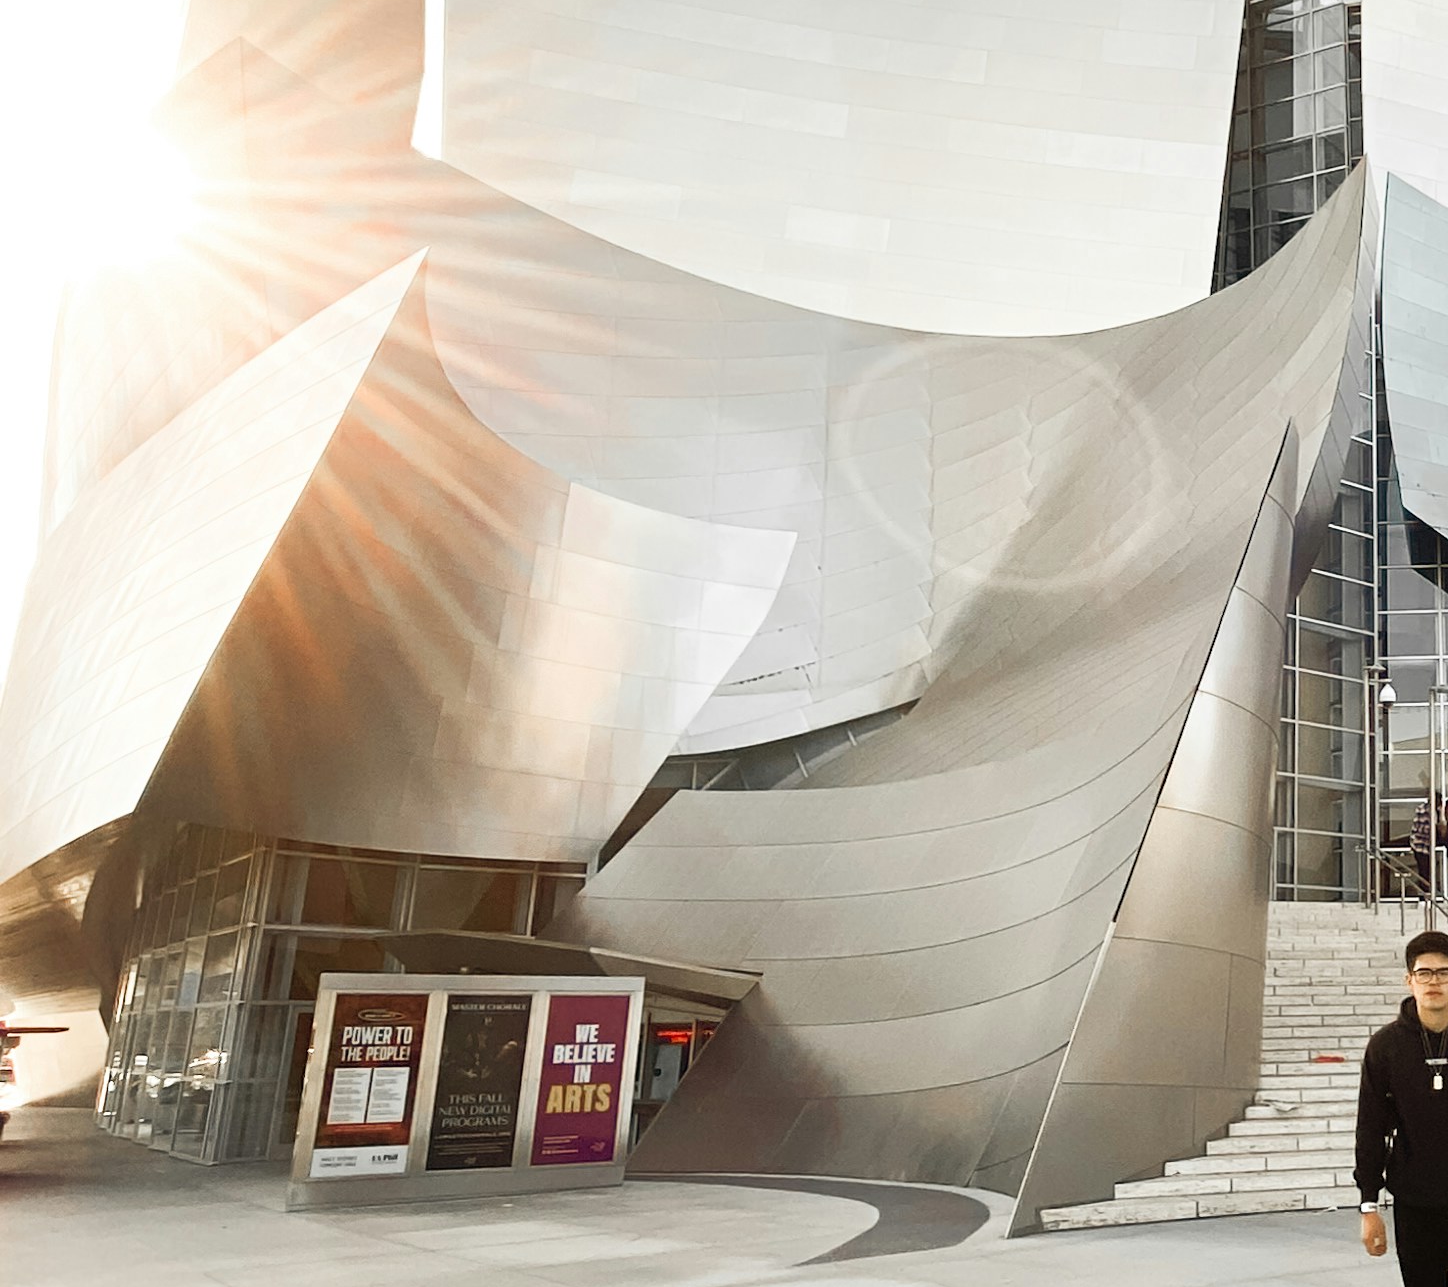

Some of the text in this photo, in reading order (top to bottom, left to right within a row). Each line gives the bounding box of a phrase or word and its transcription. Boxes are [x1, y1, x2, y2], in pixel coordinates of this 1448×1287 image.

[342, 1026, 413, 1045] POWER TO
[575, 1024, 600, 1044] WE
[341, 1046, 411, 1062] THE PEOPLE!
[552, 1043, 616, 1064] BELIEVE
[573, 1064, 592, 1084] IN
[449, 1093, 504, 1105] THIS FALL
[545, 1083, 612, 1114] ARTS
[439, 1104, 511, 1116] NEW DIGITAL
[441, 1115, 510, 1129] PROGRAMS
